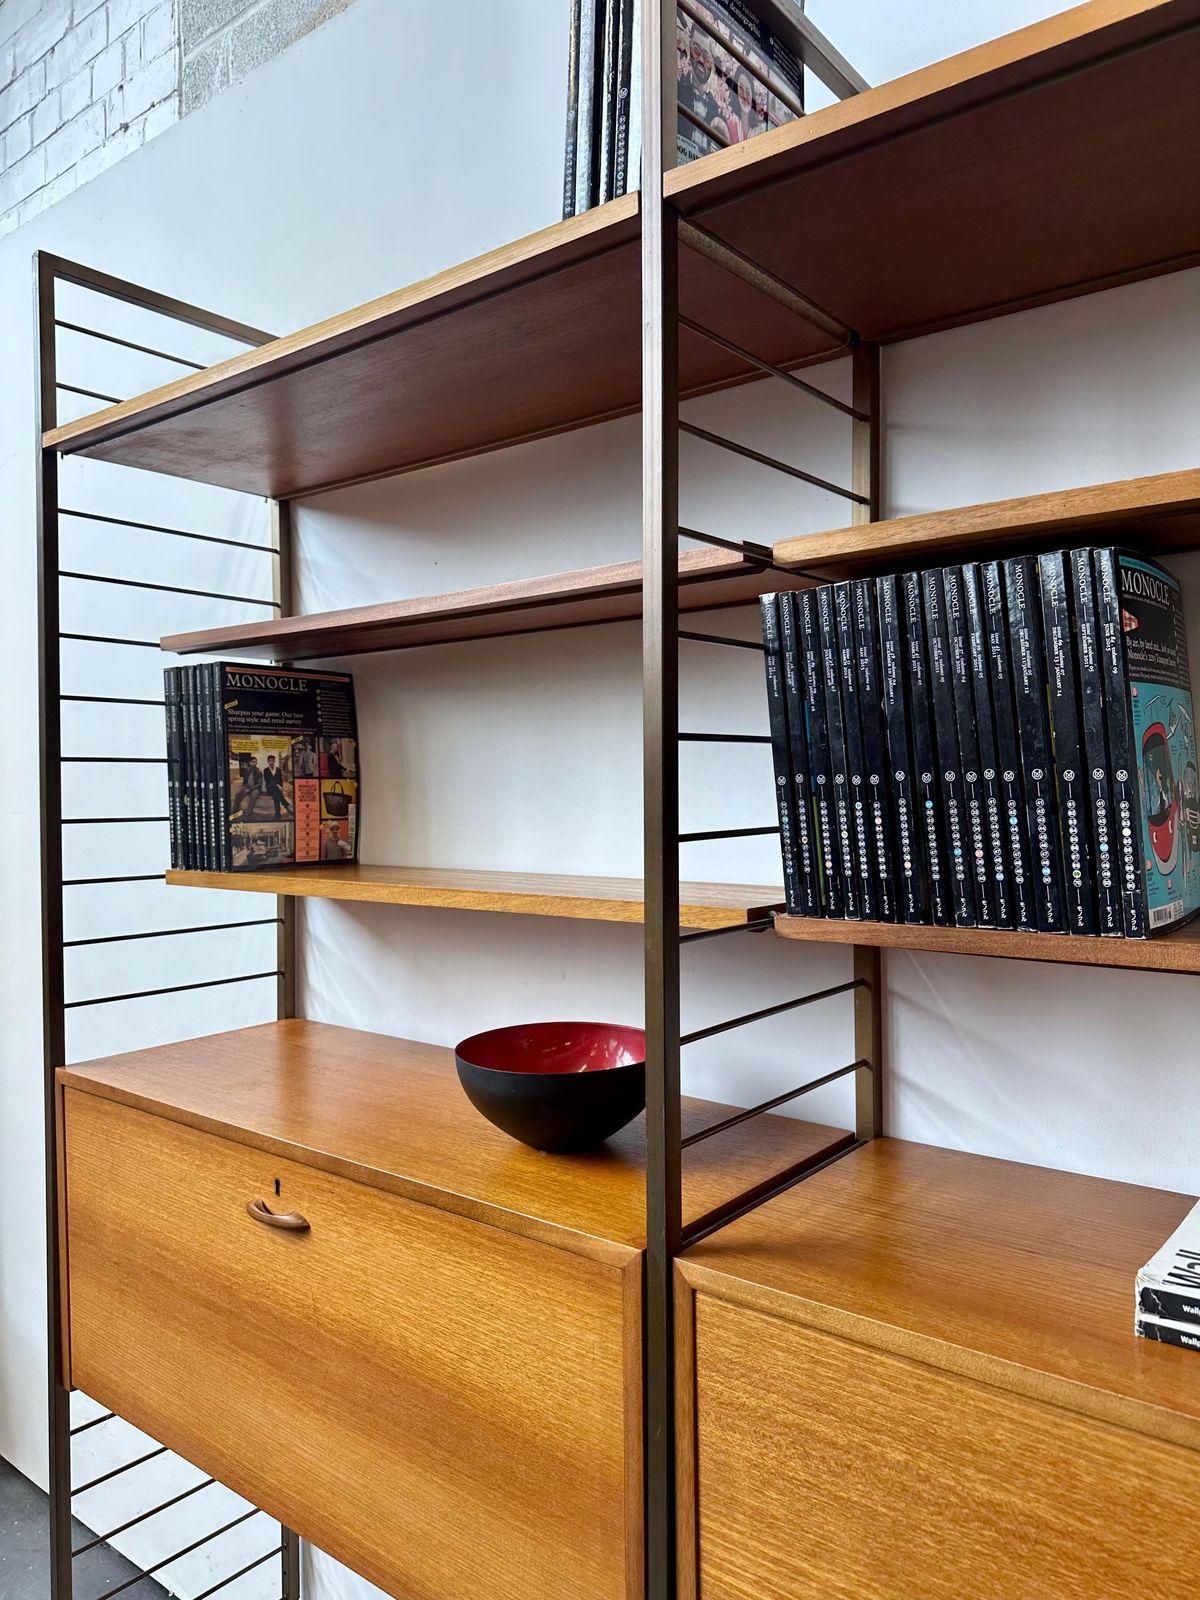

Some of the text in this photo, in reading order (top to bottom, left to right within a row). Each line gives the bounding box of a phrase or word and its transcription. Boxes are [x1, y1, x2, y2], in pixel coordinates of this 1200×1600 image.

[929, 577, 938, 619] MONOCLE
[949, 575, 959, 618] MONOCLE
[966, 571, 976, 615] MONOCLE
[986, 570, 996, 614] MONOCLE
[1015, 565, 1025, 609] MONOCLE
[1048, 562, 1058, 607] MONOCLE
[1077, 557, 1087, 603] MONOCLE
[1101, 557, 1111, 603] MONOCLE
[1121, 569, 1169, 605] MONOCLE
[764, 602, 773, 639] MONOCLE
[782, 596, 791, 635] MONOCLE
[802, 595, 811, 634] MONOCLE
[821, 592, 830, 632] MONOCLE
[839, 591, 847, 631] MONOCLE
[856, 588, 865, 629] MONOCLE
[883, 581, 891, 623] MONOCLE
[907, 581, 916, 623] MONOCLE
[226, 673, 308, 692] MONOCLE
